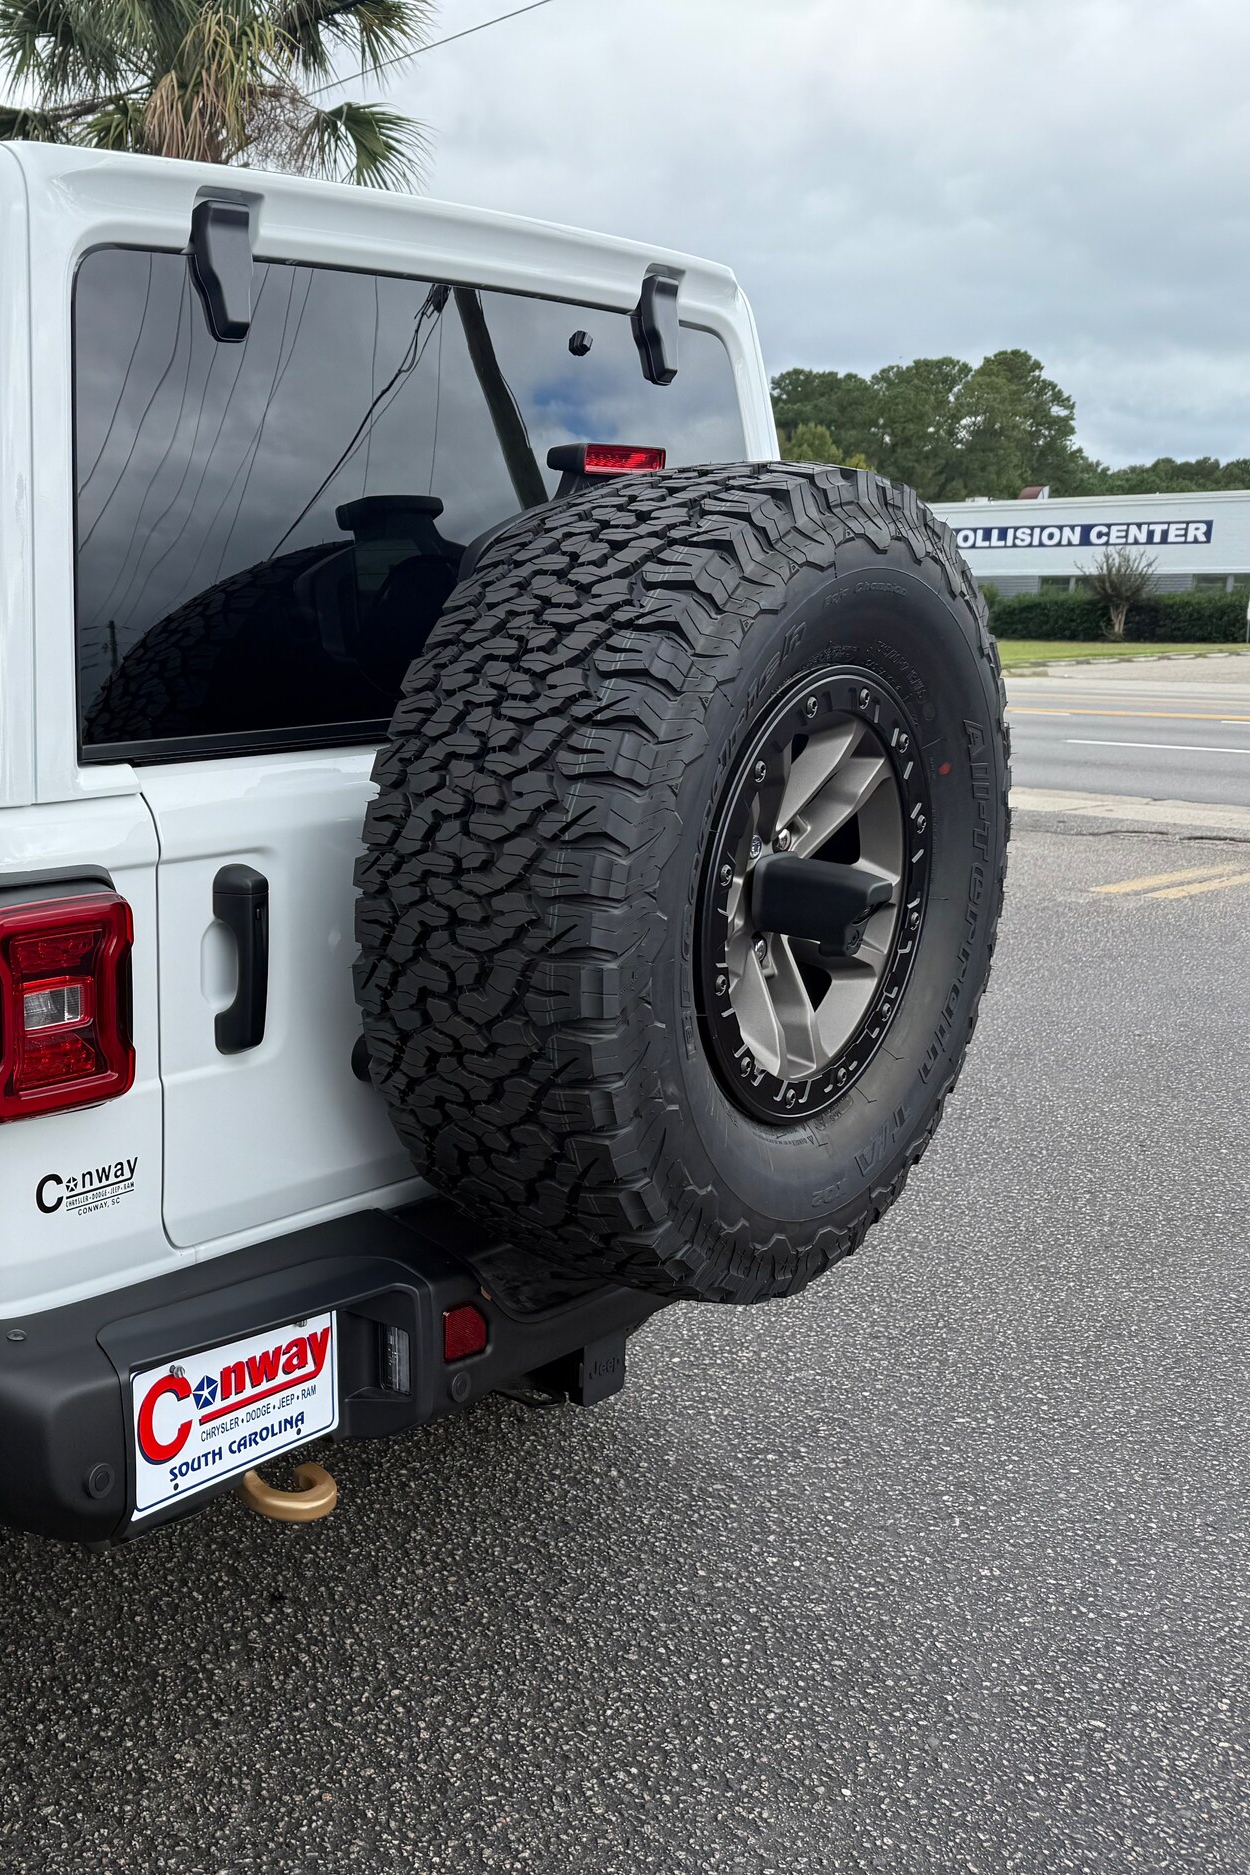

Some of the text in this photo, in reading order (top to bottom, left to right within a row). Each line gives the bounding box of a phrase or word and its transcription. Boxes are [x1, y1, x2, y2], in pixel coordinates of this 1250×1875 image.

[952, 522, 1207, 549] OLLISION CENTER
[77, 1196, 121, 1216] CONWAY, SC
[588, 1356, 620, 1380] Jeep
[200, 1384, 317, 1443] CHRYSLER DODGE JEEP RAM
[169, 1411, 305, 1483] SOUTH CAROLINA
